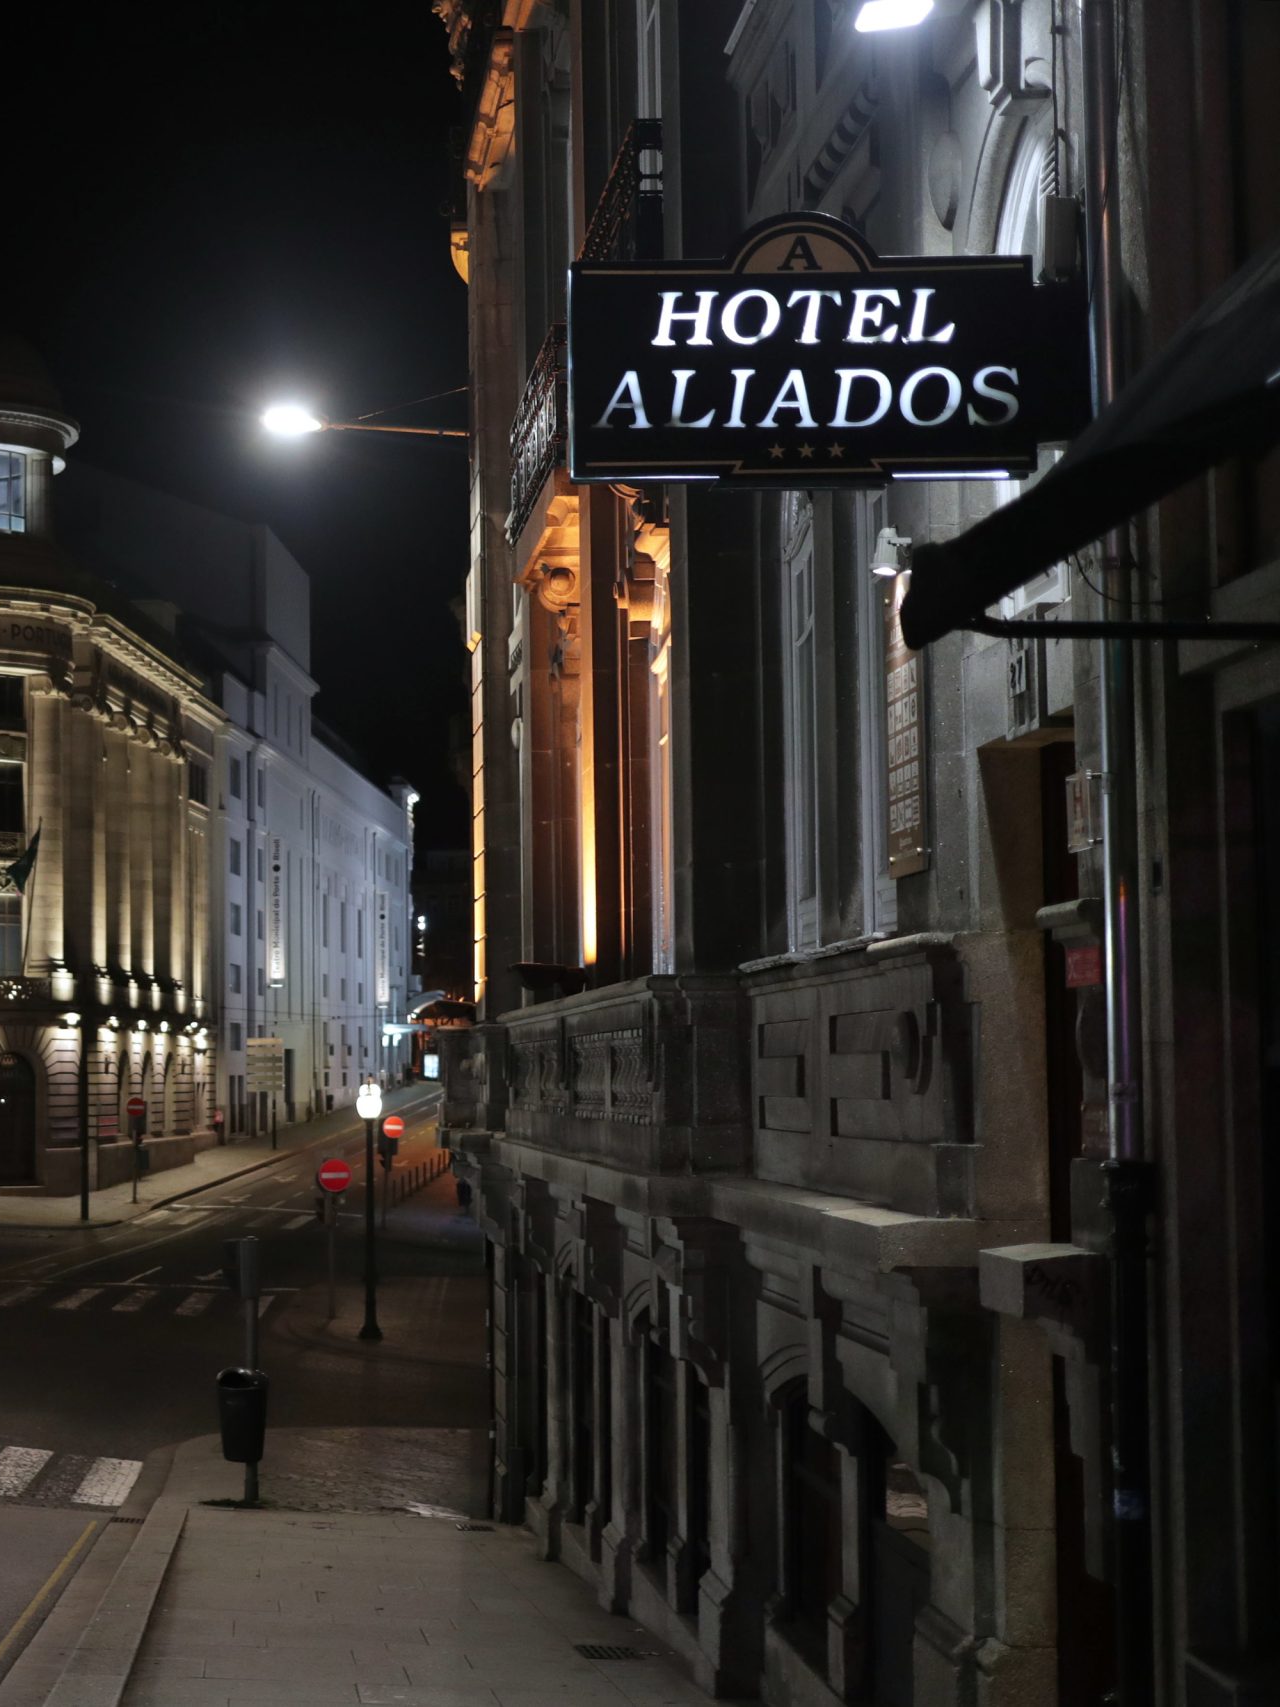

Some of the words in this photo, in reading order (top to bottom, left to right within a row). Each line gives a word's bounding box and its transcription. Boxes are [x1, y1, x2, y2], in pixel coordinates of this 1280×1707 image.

[777, 235, 822, 271] A
[651, 287, 956, 347] HOTEL
[591, 365, 1020, 429] ALIADOS
[272, 876, 280, 897] Porto
[272, 910, 281, 949] Municipal
